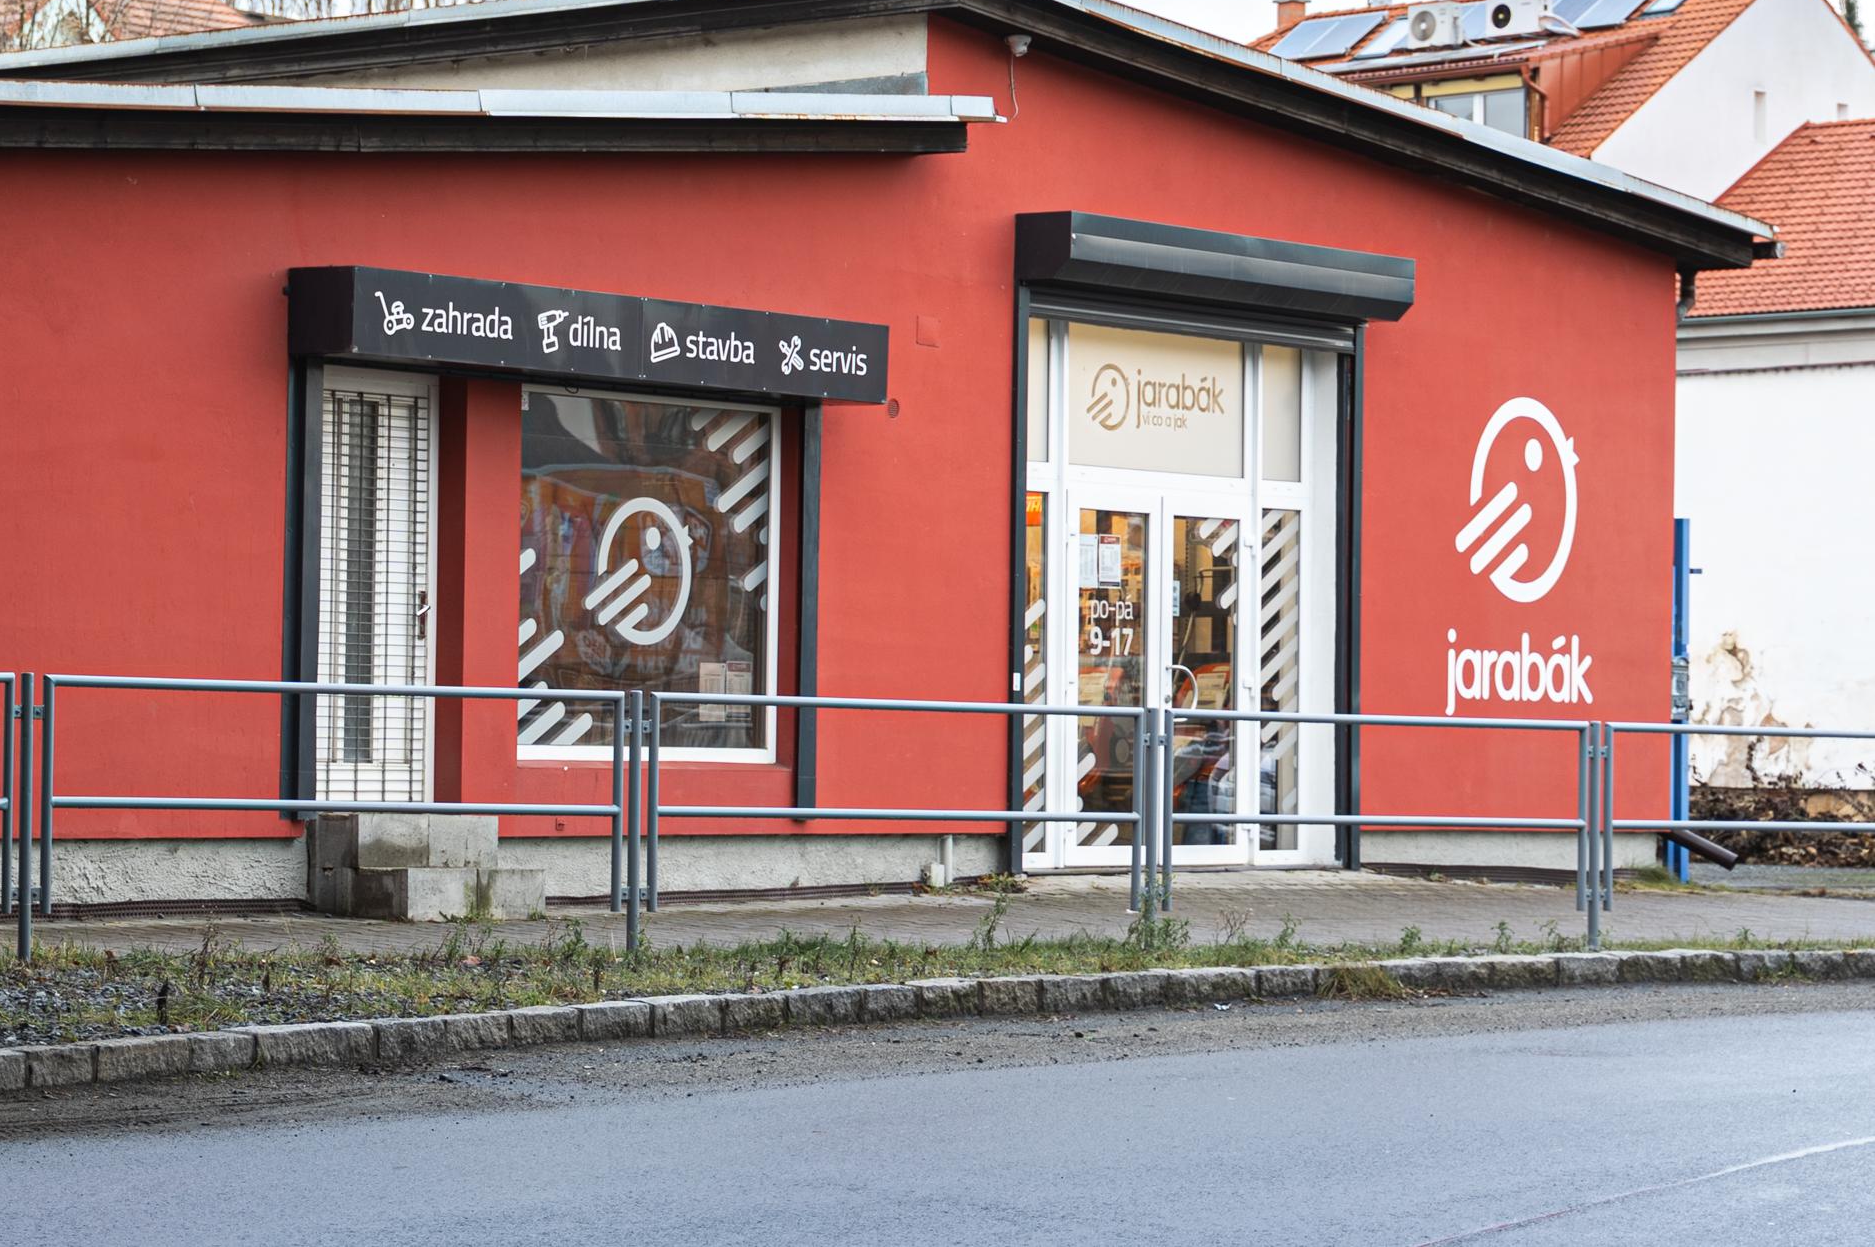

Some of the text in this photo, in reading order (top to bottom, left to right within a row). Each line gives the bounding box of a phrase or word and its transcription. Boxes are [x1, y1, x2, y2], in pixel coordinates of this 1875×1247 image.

[421, 302, 868, 376] zahrada dílna stavba servis
[1136, 368, 1225, 429] jarabák
[1090, 626, 1134, 656] 9-17
[1444, 628, 1594, 717] jarabák
